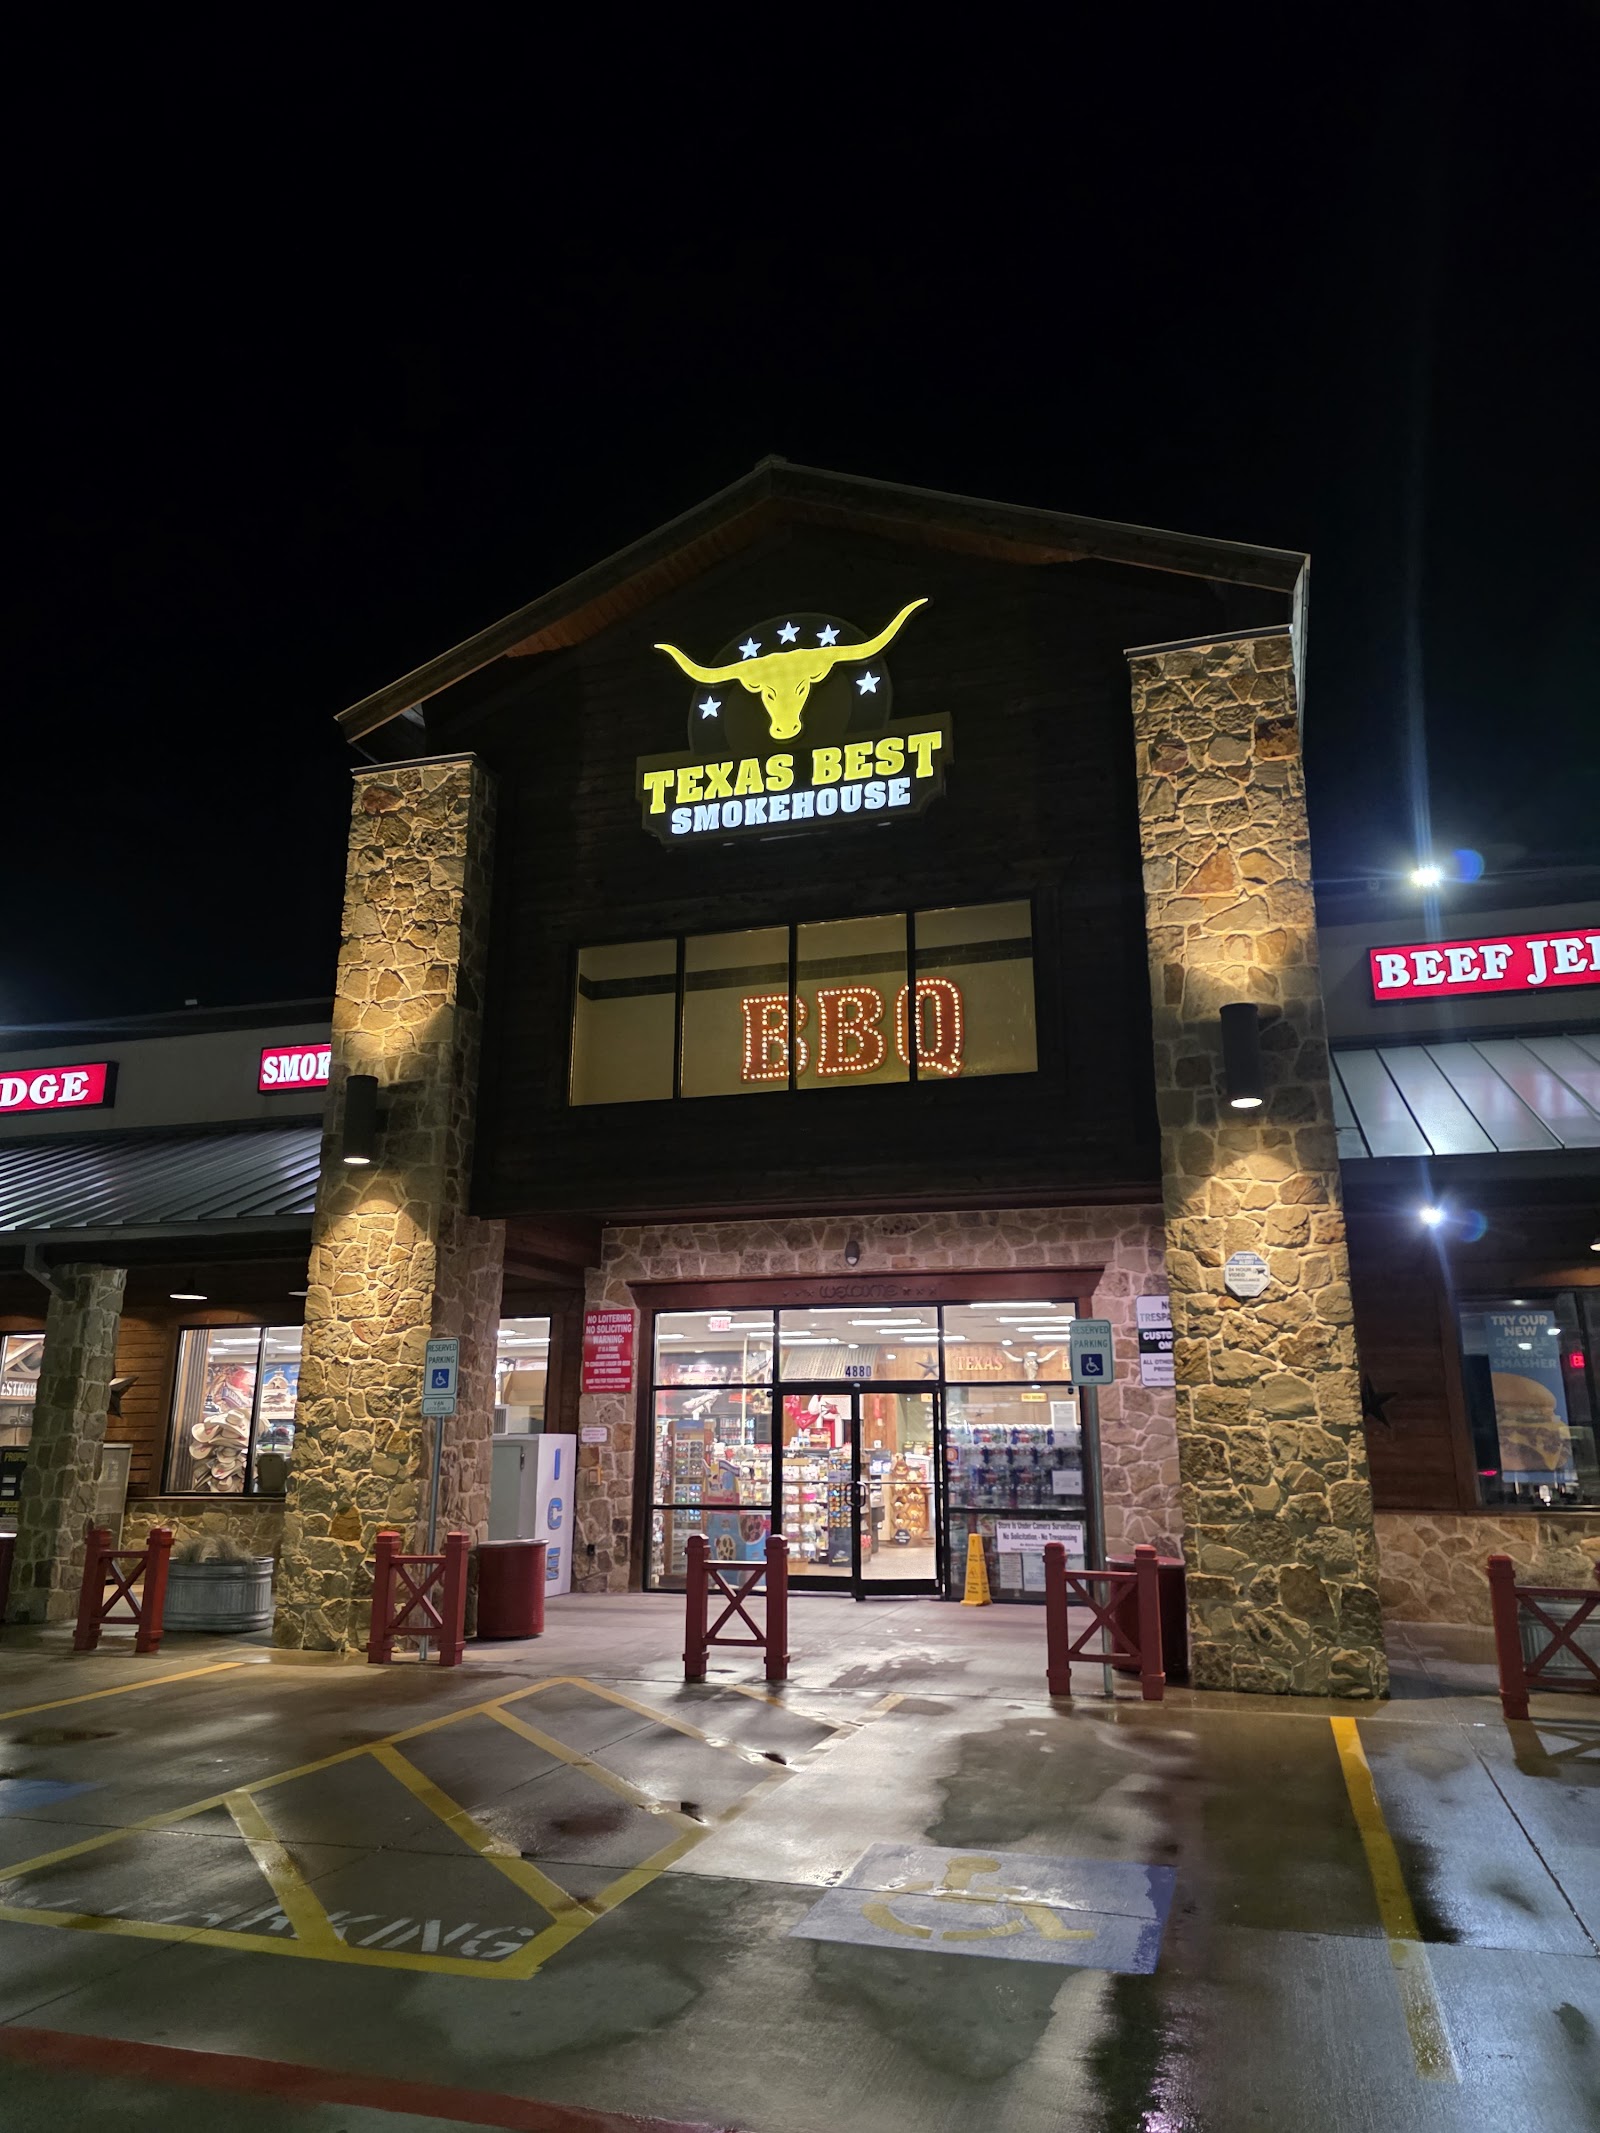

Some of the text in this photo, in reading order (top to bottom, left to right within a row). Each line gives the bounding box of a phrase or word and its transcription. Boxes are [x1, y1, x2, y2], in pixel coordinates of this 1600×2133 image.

[643, 731, 942, 814] TEXAS BEST
[671, 777, 911, 835] SMOKEHOUSE
[1375, 944, 1513, 989] BEEF
[741, 976, 964, 1083] BBQ
[0, 1071, 89, 1107] DGE
[587, 1314, 631, 1324] NO LOITERING
[1490, 1315, 1548, 1326] TRY OUR
[586, 1324, 632, 1334] NO SOLICITING
[1072, 1326, 1109, 1334] RESERVED
[1504, 1327, 1538, 1337] NEW
[428, 1344, 457, 1352] RESERVED
[1074, 1340, 1108, 1348] PARKING
[428, 1356, 455, 1364] PARKING
[957, 1356, 1004, 1371] TEXAS
[845, 1365, 872, 1377] 4880
[1033, 1522, 1051, 1530] Camera
